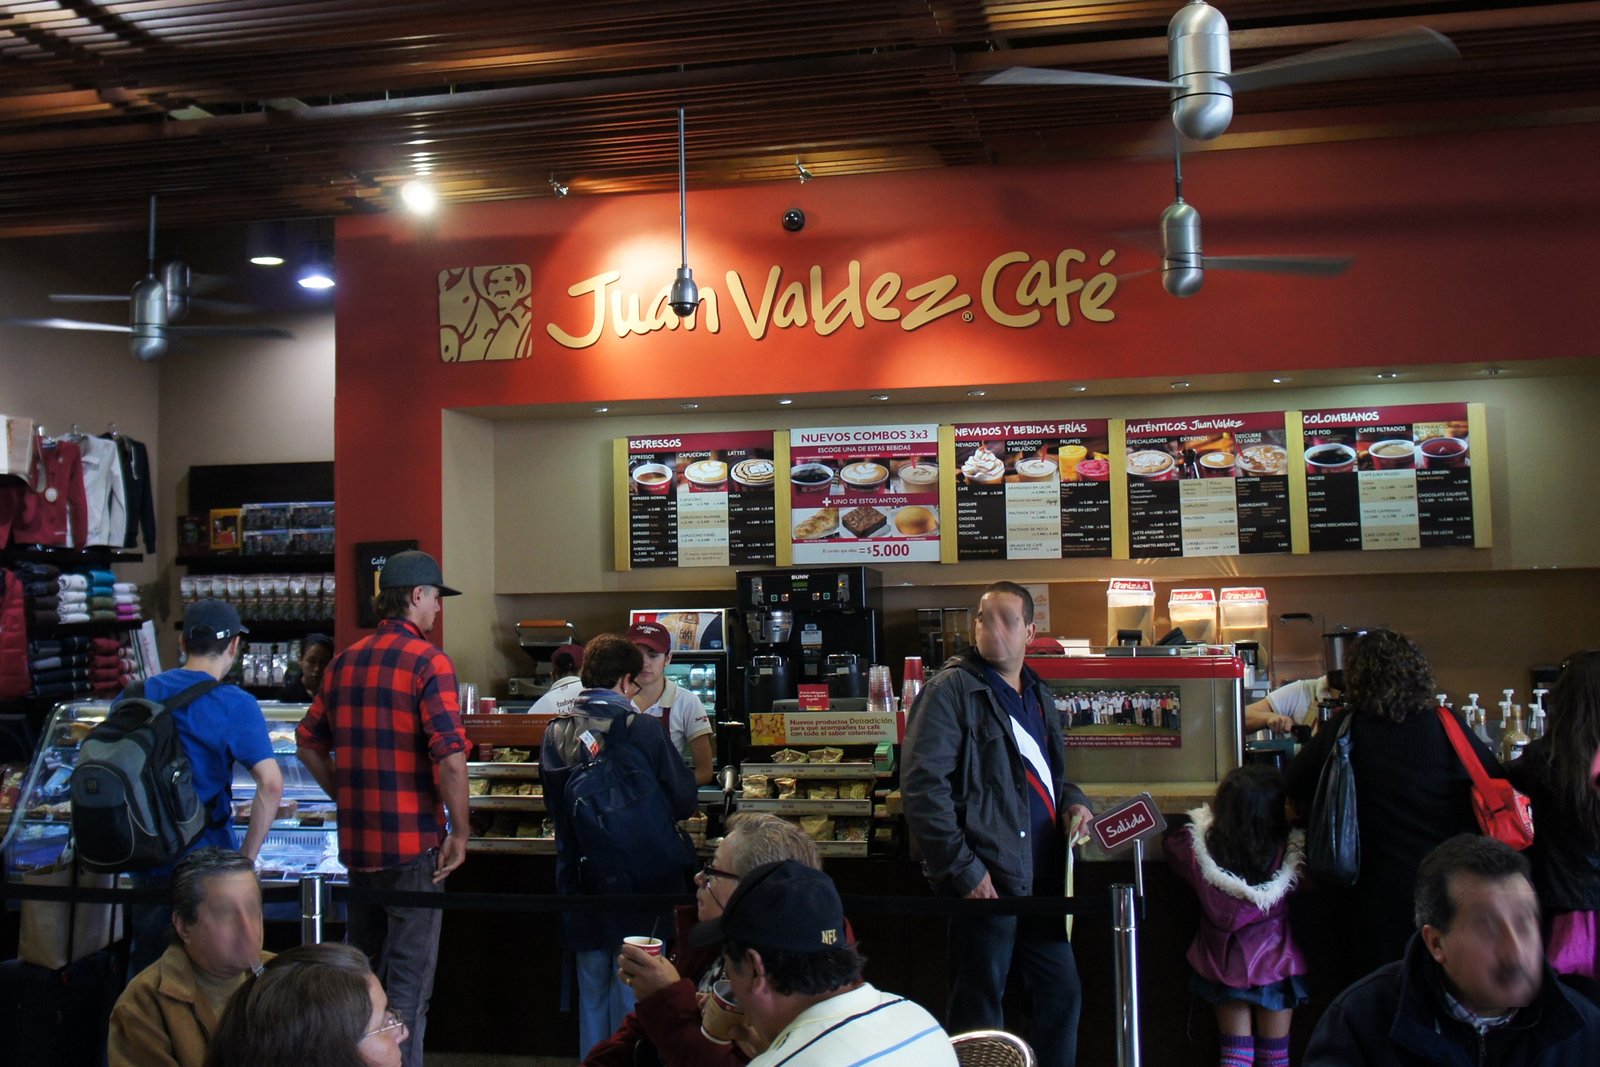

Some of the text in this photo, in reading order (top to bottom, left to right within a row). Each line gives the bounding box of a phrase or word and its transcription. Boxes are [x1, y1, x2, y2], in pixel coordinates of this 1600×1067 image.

[546, 249, 1117, 348] Juan Valdez Café
[1303, 411, 1379, 424] COLOMBIANOS
[955, 422, 1088, 437] NEVADOS Y BEBIDAS FRÍAS
[1126, 419, 1244, 434] AUTÉNTICOS Juan Valdez
[1376, 425, 1406, 433] FILTRADOS
[801, 430, 929, 444] NUEVOS COMBOS 3x3
[1007, 439, 1042, 447] GRANIZADOS
[629, 439, 682, 449] ESPRESSOS
[816, 719, 848, 727] productos
[820, 724, 857, 733] acompañes
[1106, 813, 1146, 838] Salida
[821, 929, 837, 945] NFL
